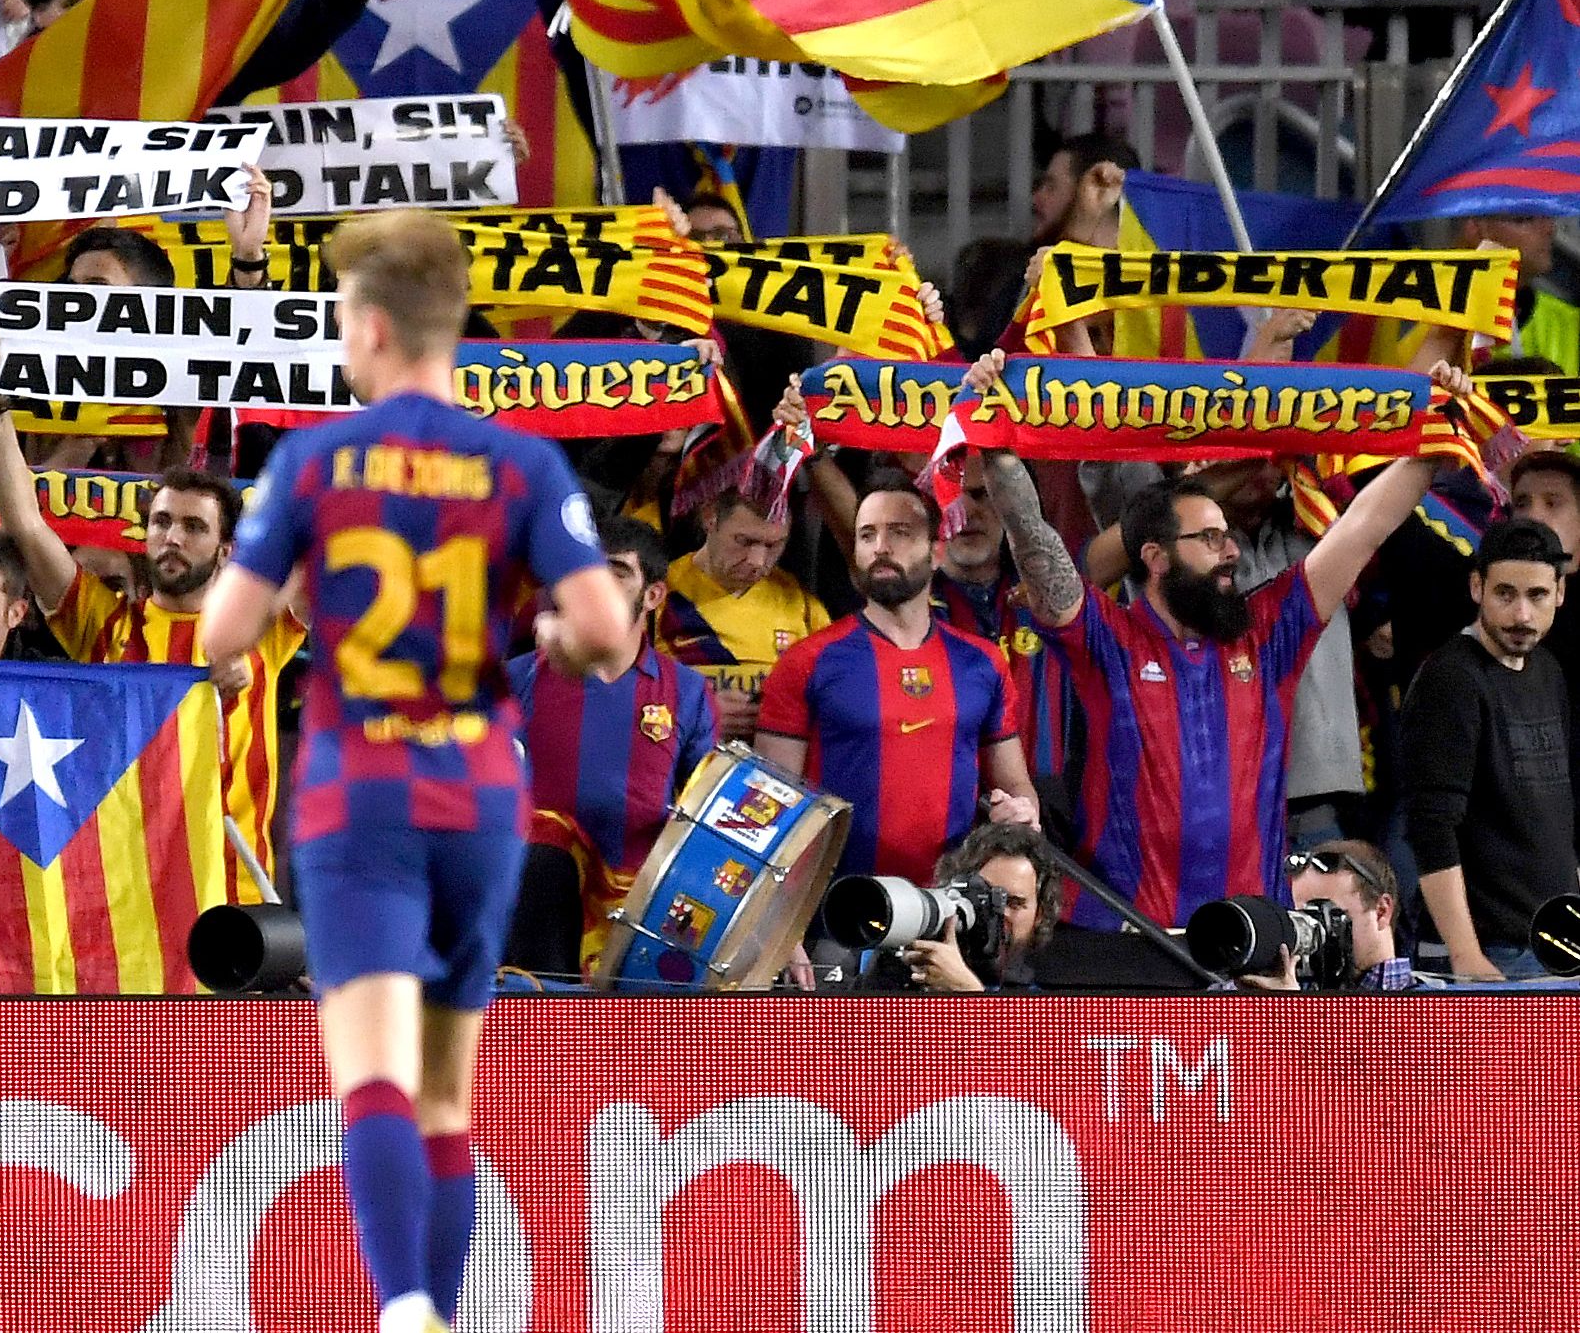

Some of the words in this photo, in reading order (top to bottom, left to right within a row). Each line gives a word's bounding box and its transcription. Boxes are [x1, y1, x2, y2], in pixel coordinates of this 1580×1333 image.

[141, 126, 258, 152] SIT
[391, 100, 497, 142] SIT
[60, 166, 241, 214] TALK
[322, 161, 500, 206] TALK
[1052, 252, 1491, 314] LLIBERTAT
[273, 298, 343, 341] SI
[970, 365, 1415, 441] Almogàvers
[326, 525, 490, 703] 21
